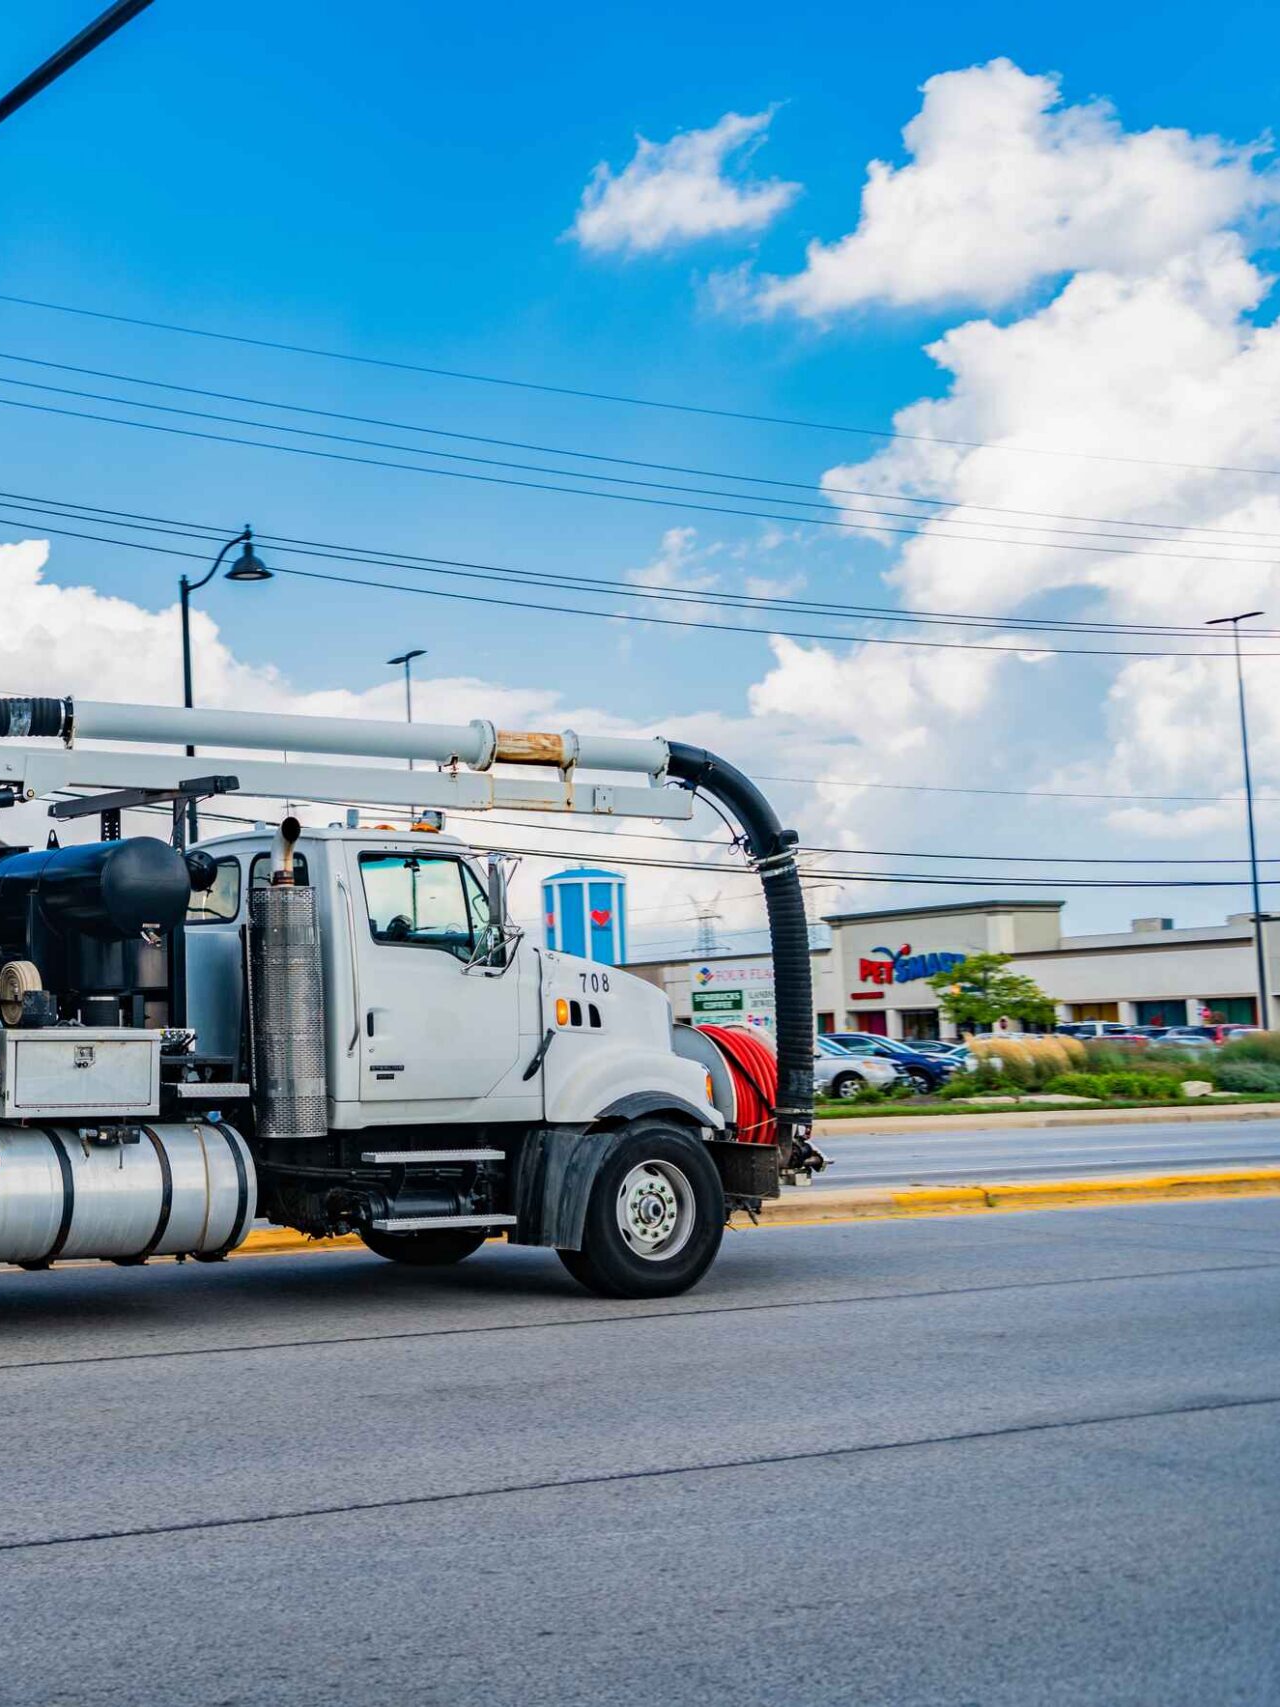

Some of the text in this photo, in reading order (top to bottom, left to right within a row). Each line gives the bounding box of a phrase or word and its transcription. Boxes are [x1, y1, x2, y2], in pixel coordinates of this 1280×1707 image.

[579, 973, 610, 993] 708
[694, 993, 741, 1002] STARBUCKS
[703, 1001, 733, 1010] COFFEE
